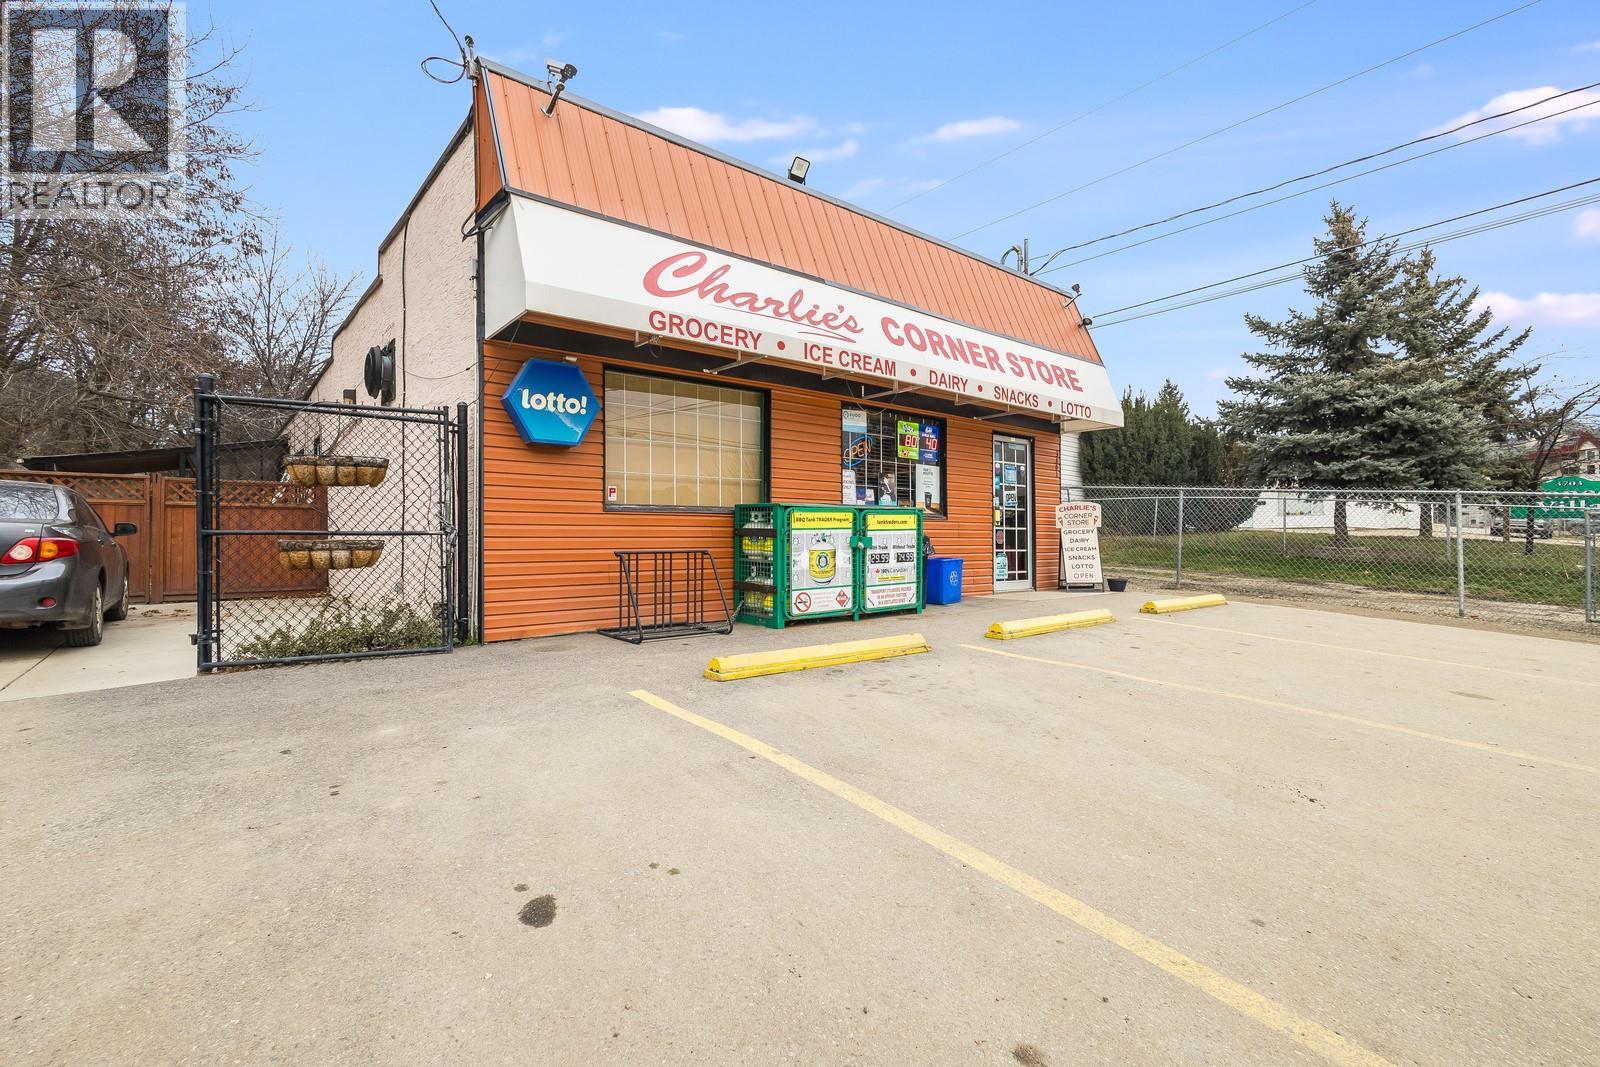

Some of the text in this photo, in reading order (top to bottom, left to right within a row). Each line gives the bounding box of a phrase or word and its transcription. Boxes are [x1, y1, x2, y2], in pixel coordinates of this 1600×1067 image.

[643, 251, 1084, 393] Charlie's CORNER STORE
[648, 310, 1092, 419] GROCERY ICE CREAM DAIRY SNACKS LOTTO
[521, 388, 588, 415] lotto!
[844, 440, 872, 463] OPEN
[905, 434, 917, 448] 80
[925, 438, 938, 451] 40
[1058, 504, 1097, 513] CHARLIE'S
